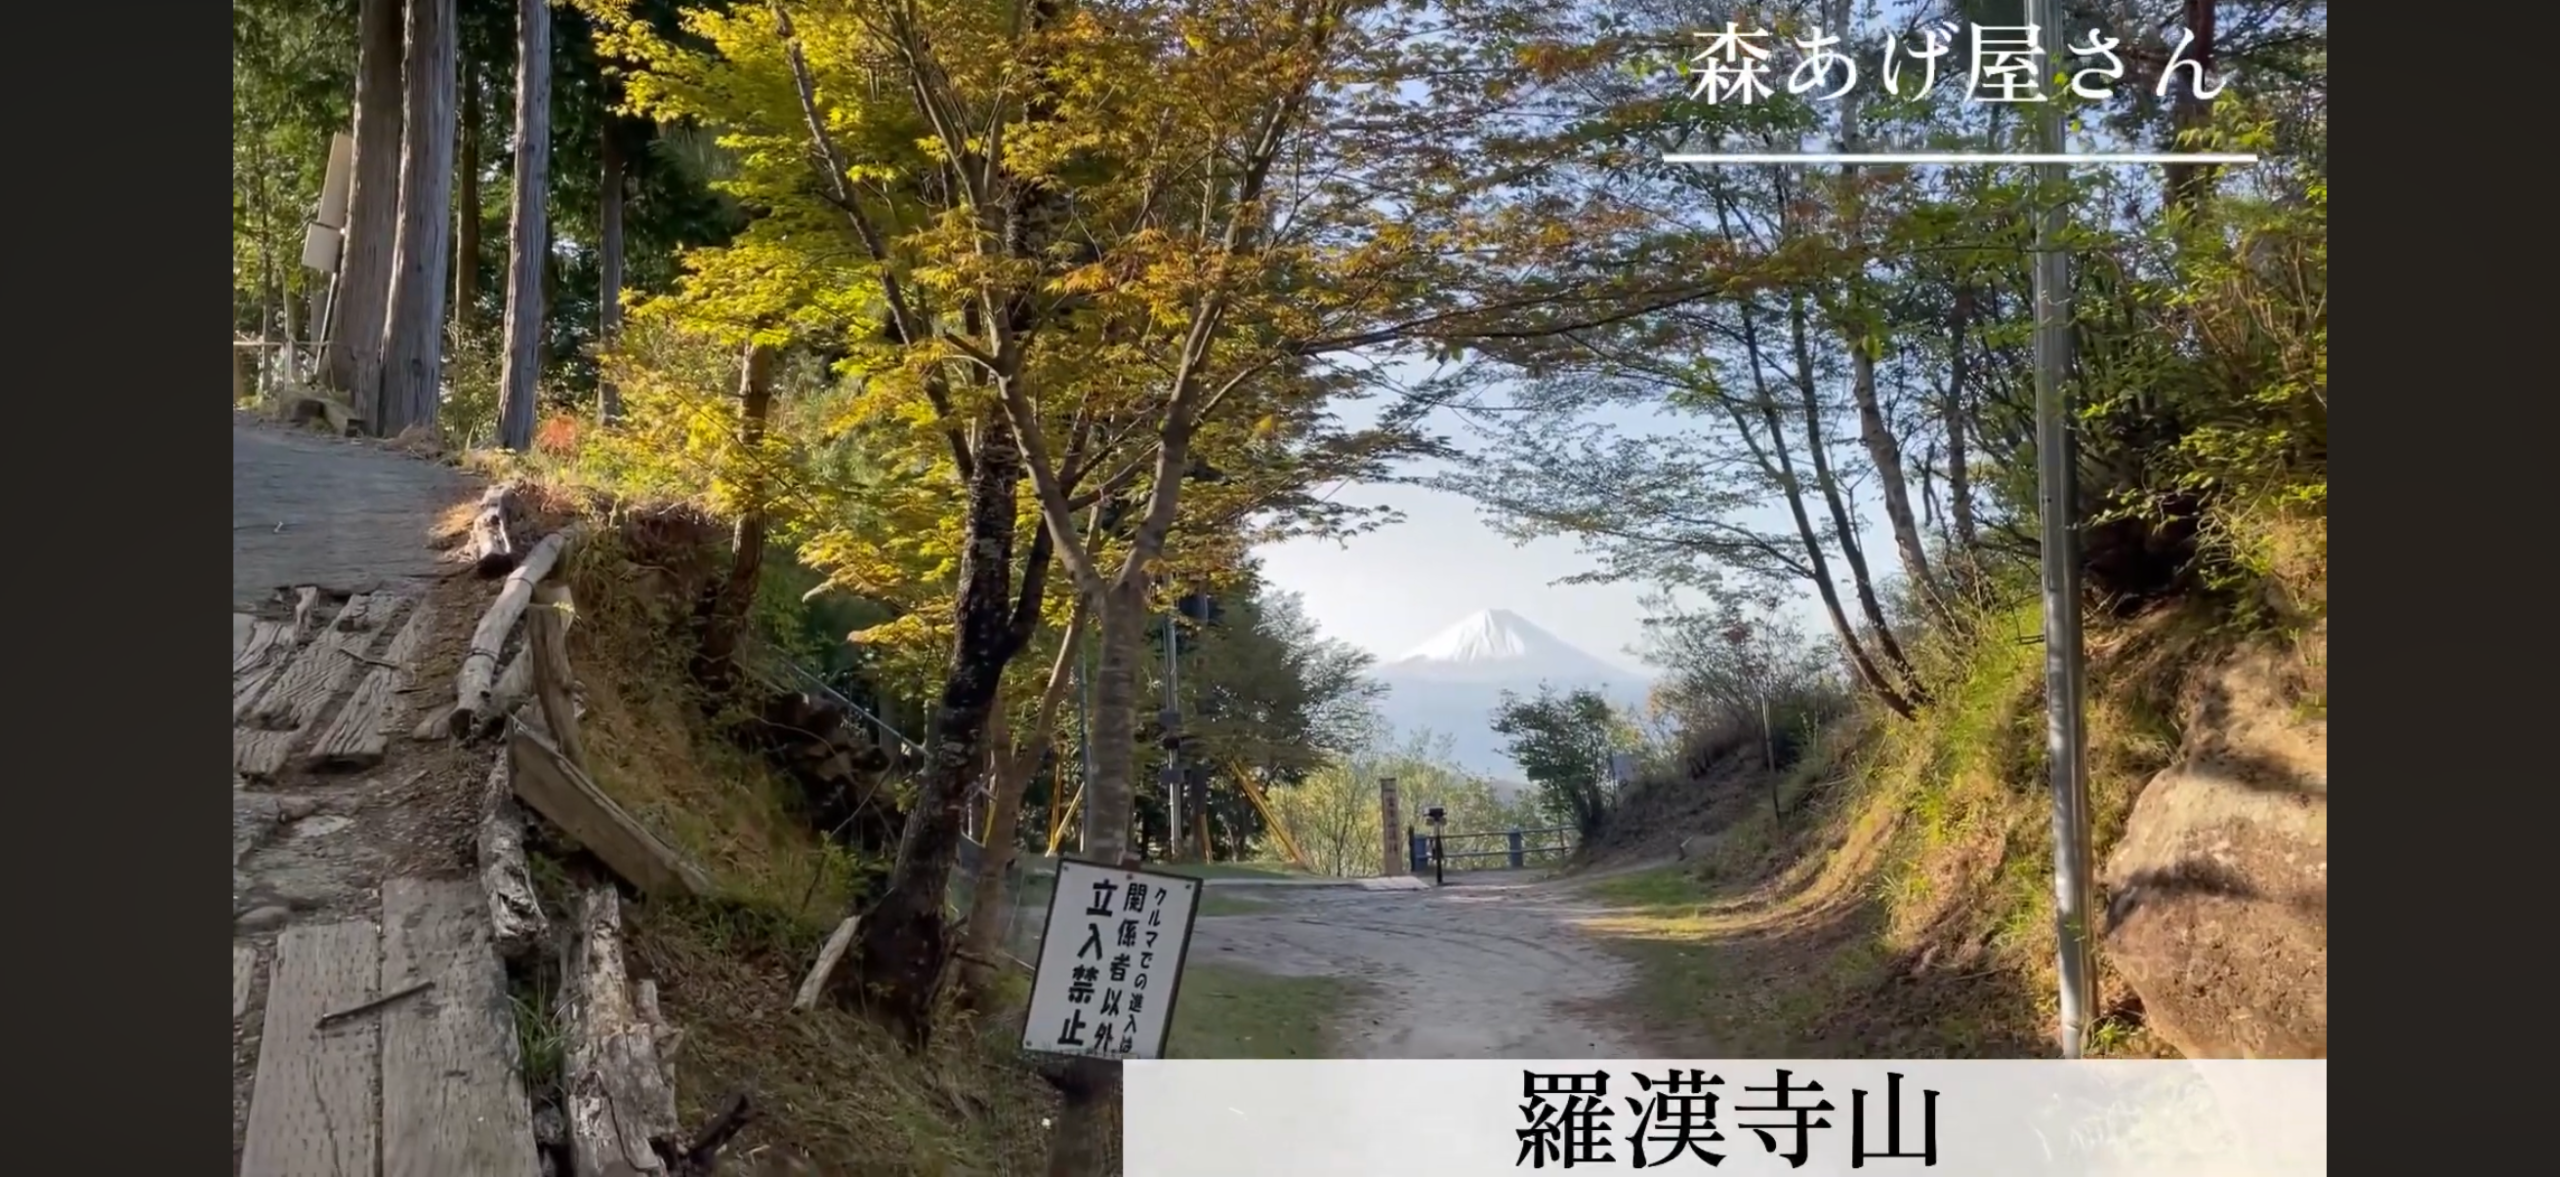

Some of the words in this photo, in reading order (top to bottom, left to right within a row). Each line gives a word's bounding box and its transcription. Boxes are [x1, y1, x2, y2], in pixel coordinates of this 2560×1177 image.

[1056, 879, 1118, 1047] 立入禁止
[1093, 882, 1148, 1053] 関係者以外
